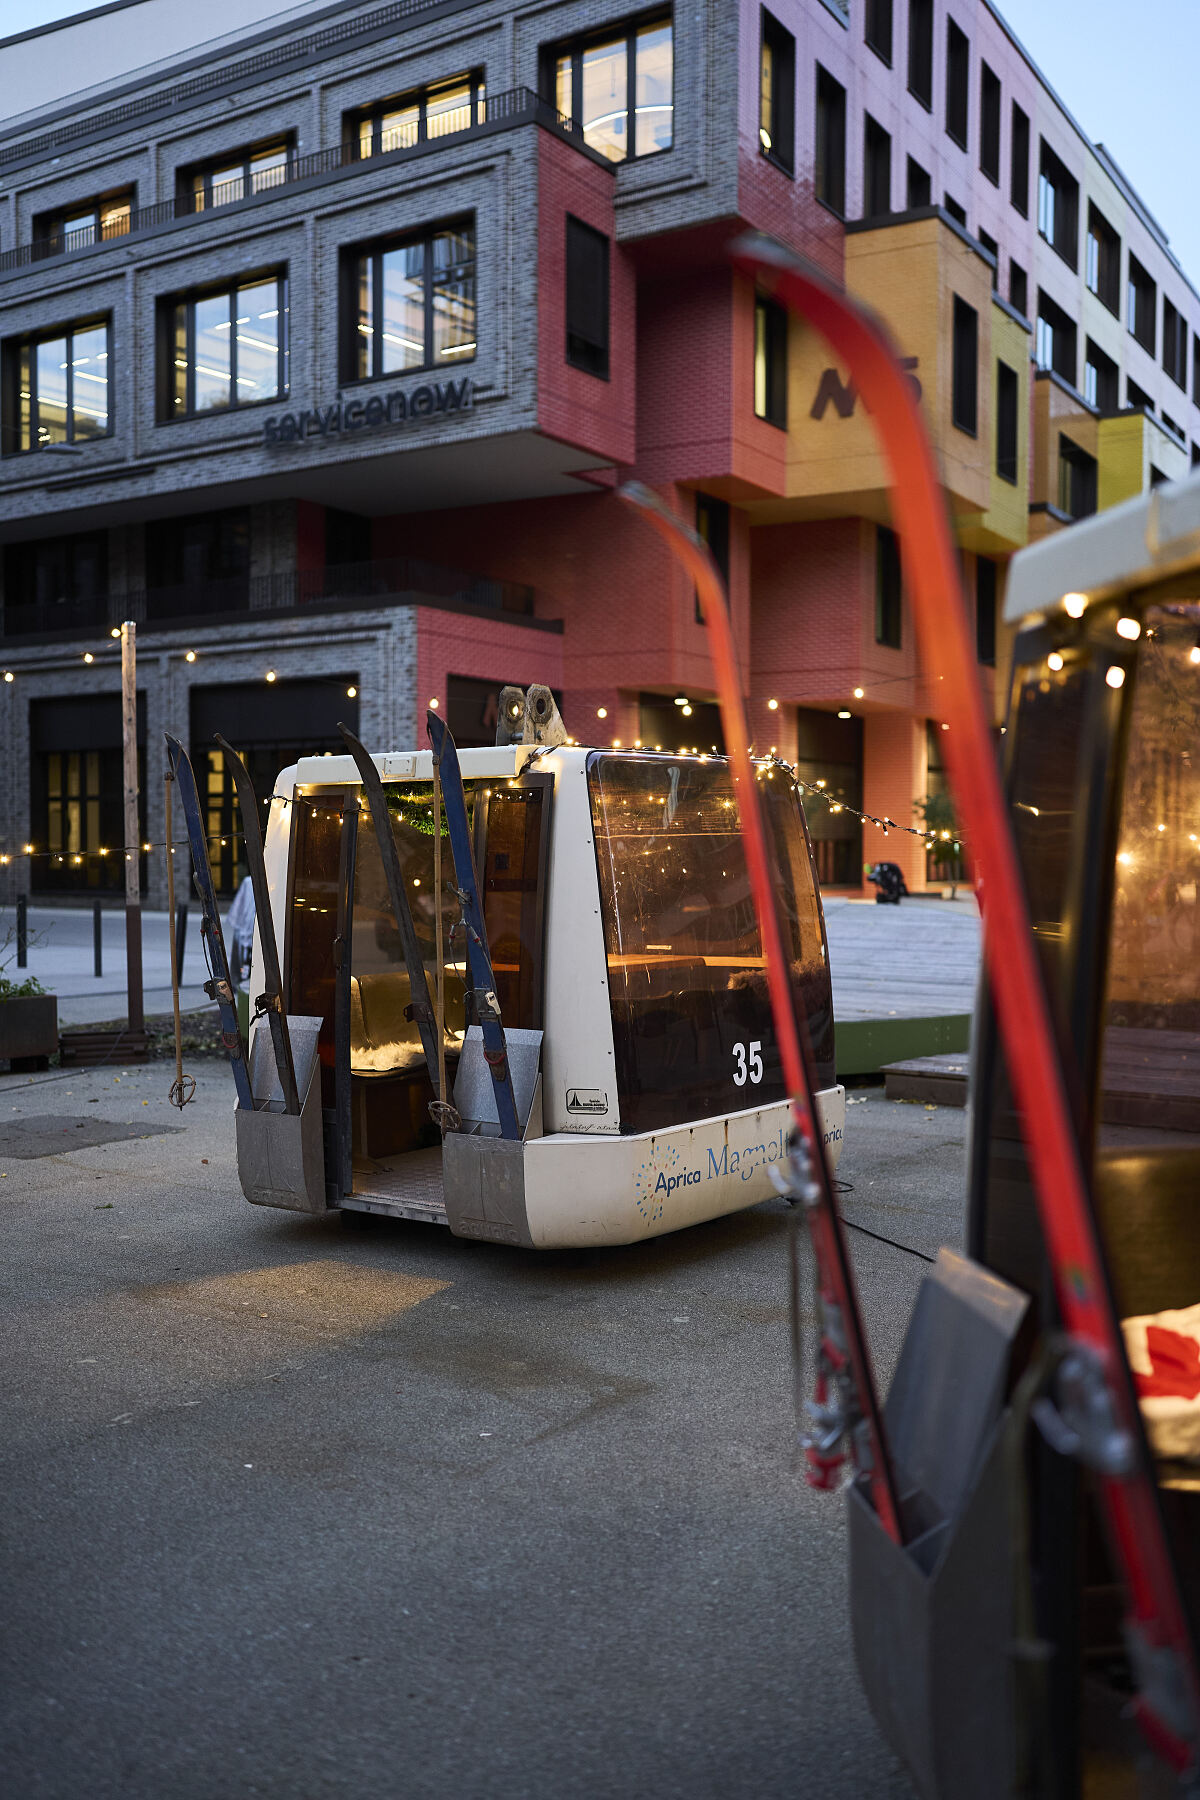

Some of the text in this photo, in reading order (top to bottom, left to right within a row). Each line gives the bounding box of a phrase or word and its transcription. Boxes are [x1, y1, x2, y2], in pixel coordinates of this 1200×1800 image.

[264, 377, 472, 443] servicenow
[732, 1041, 763, 1086] 35
[655, 1129, 798, 1198] Aprica Magnolt
